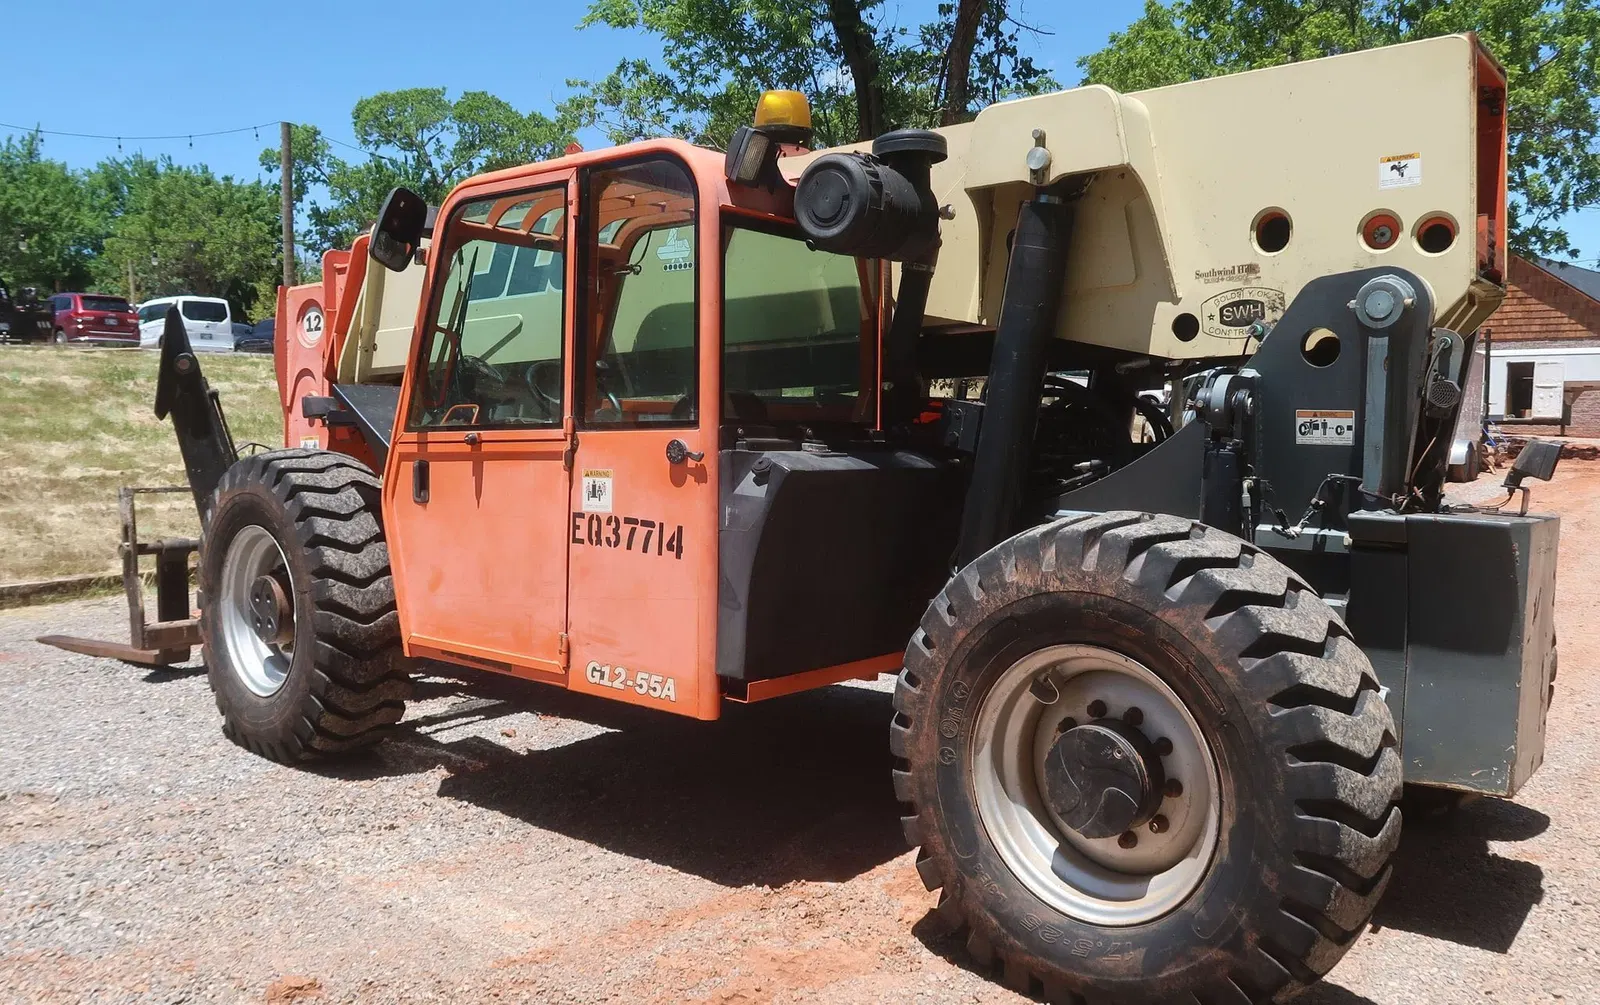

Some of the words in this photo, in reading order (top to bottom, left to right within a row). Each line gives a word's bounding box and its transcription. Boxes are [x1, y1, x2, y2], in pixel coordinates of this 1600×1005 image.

[1195, 265, 1236, 281] Southwind
[1222, 303, 1262, 322] SWH
[306, 314, 321, 333] 12
[572, 511, 684, 560] EQ37714
[584, 660, 677, 703] G12-55A
